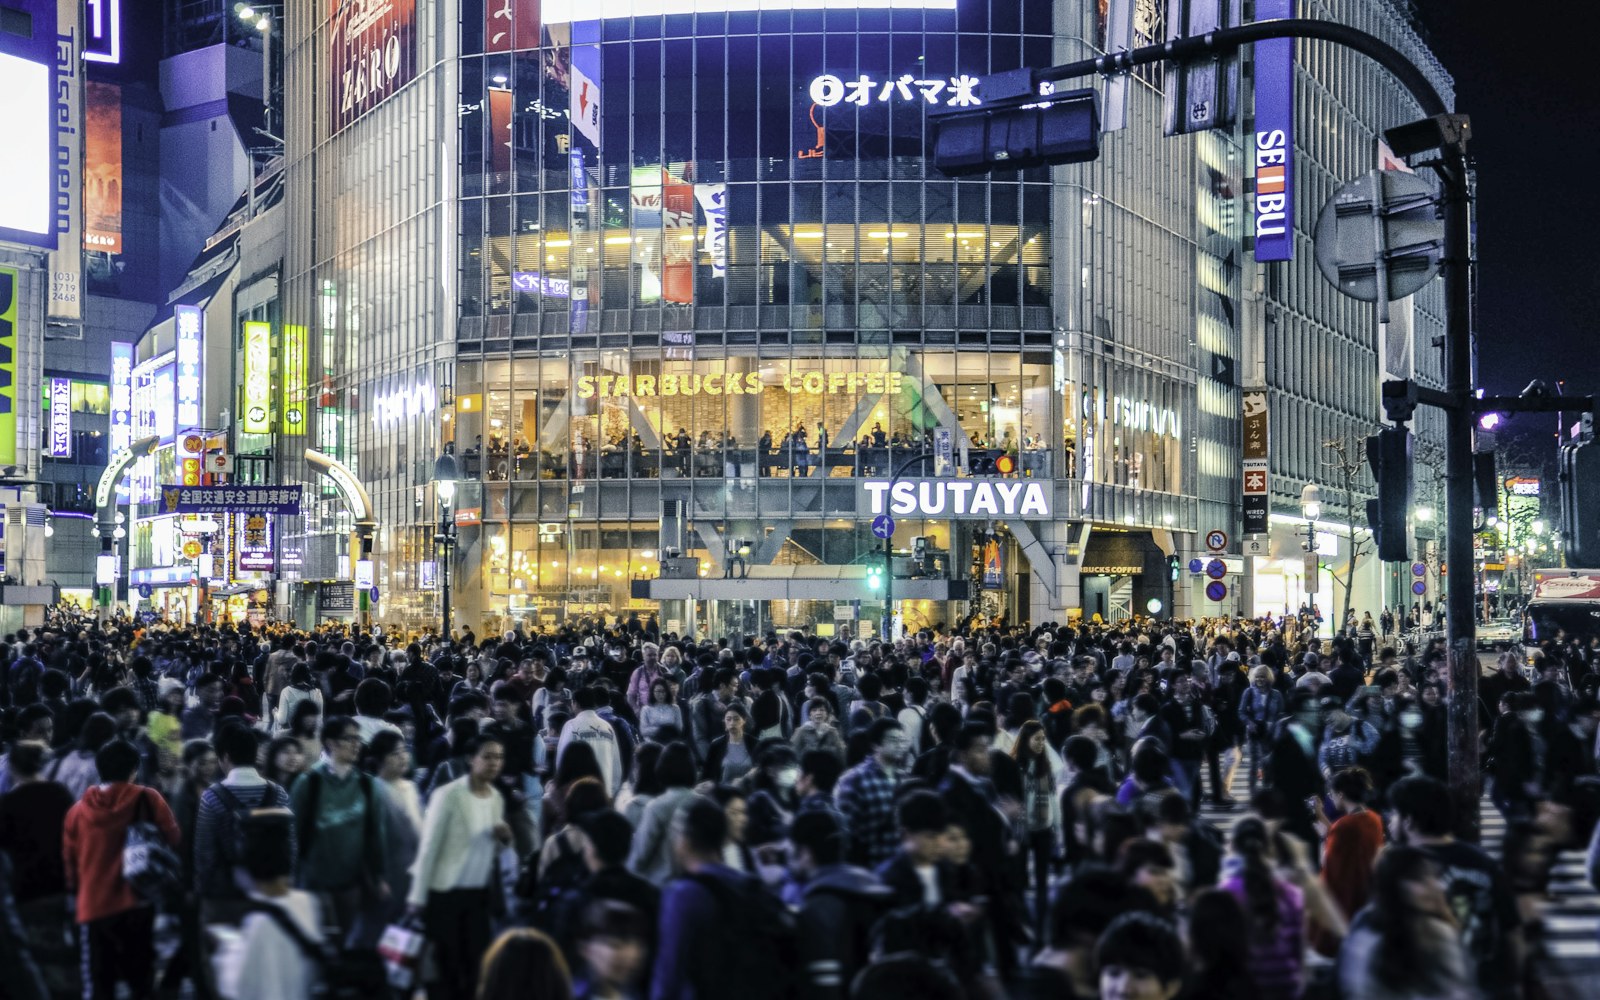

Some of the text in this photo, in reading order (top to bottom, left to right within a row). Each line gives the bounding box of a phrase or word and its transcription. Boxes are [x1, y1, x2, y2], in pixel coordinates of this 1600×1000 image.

[341, 35, 399, 113] ZERO
[1256, 130, 1286, 239] SEIBU
[54, 272, 75, 282] (03)
[53, 283, 76, 292] 3719
[52, 292, 76, 302] 2468
[577, 371, 902, 399] STARBUCKS COFFEE
[1246, 473, 1264, 491] 本
[180, 490, 299, 505] 全国交通安全運動実施中
[863, 482, 1049, 515] TSUTAYA
[1110, 566, 1143, 574] COFFEE
